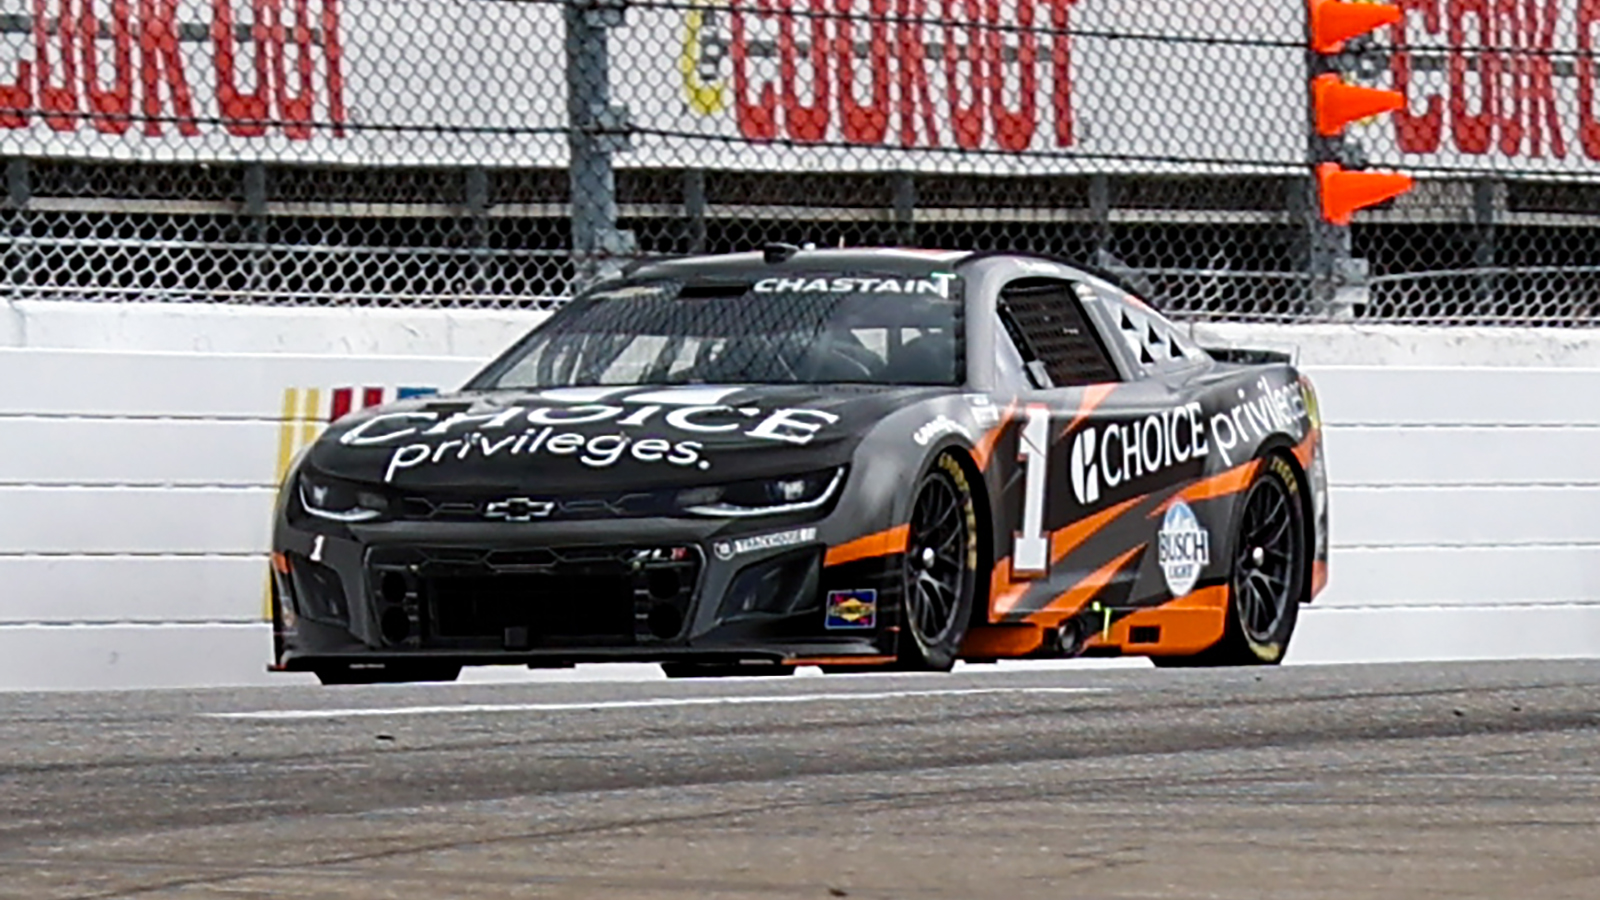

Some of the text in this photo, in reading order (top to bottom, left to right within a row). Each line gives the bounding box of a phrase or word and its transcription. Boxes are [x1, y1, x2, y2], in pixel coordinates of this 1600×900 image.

[753, 277, 948, 295] CHASTAIN
[340, 402, 841, 446] CHOICE
[1101, 401, 1209, 487] CHOICE
[1012, 404, 1051, 574] 1
[309, 535, 325, 561] 1
[1159, 531, 1207, 562] BUSCH
